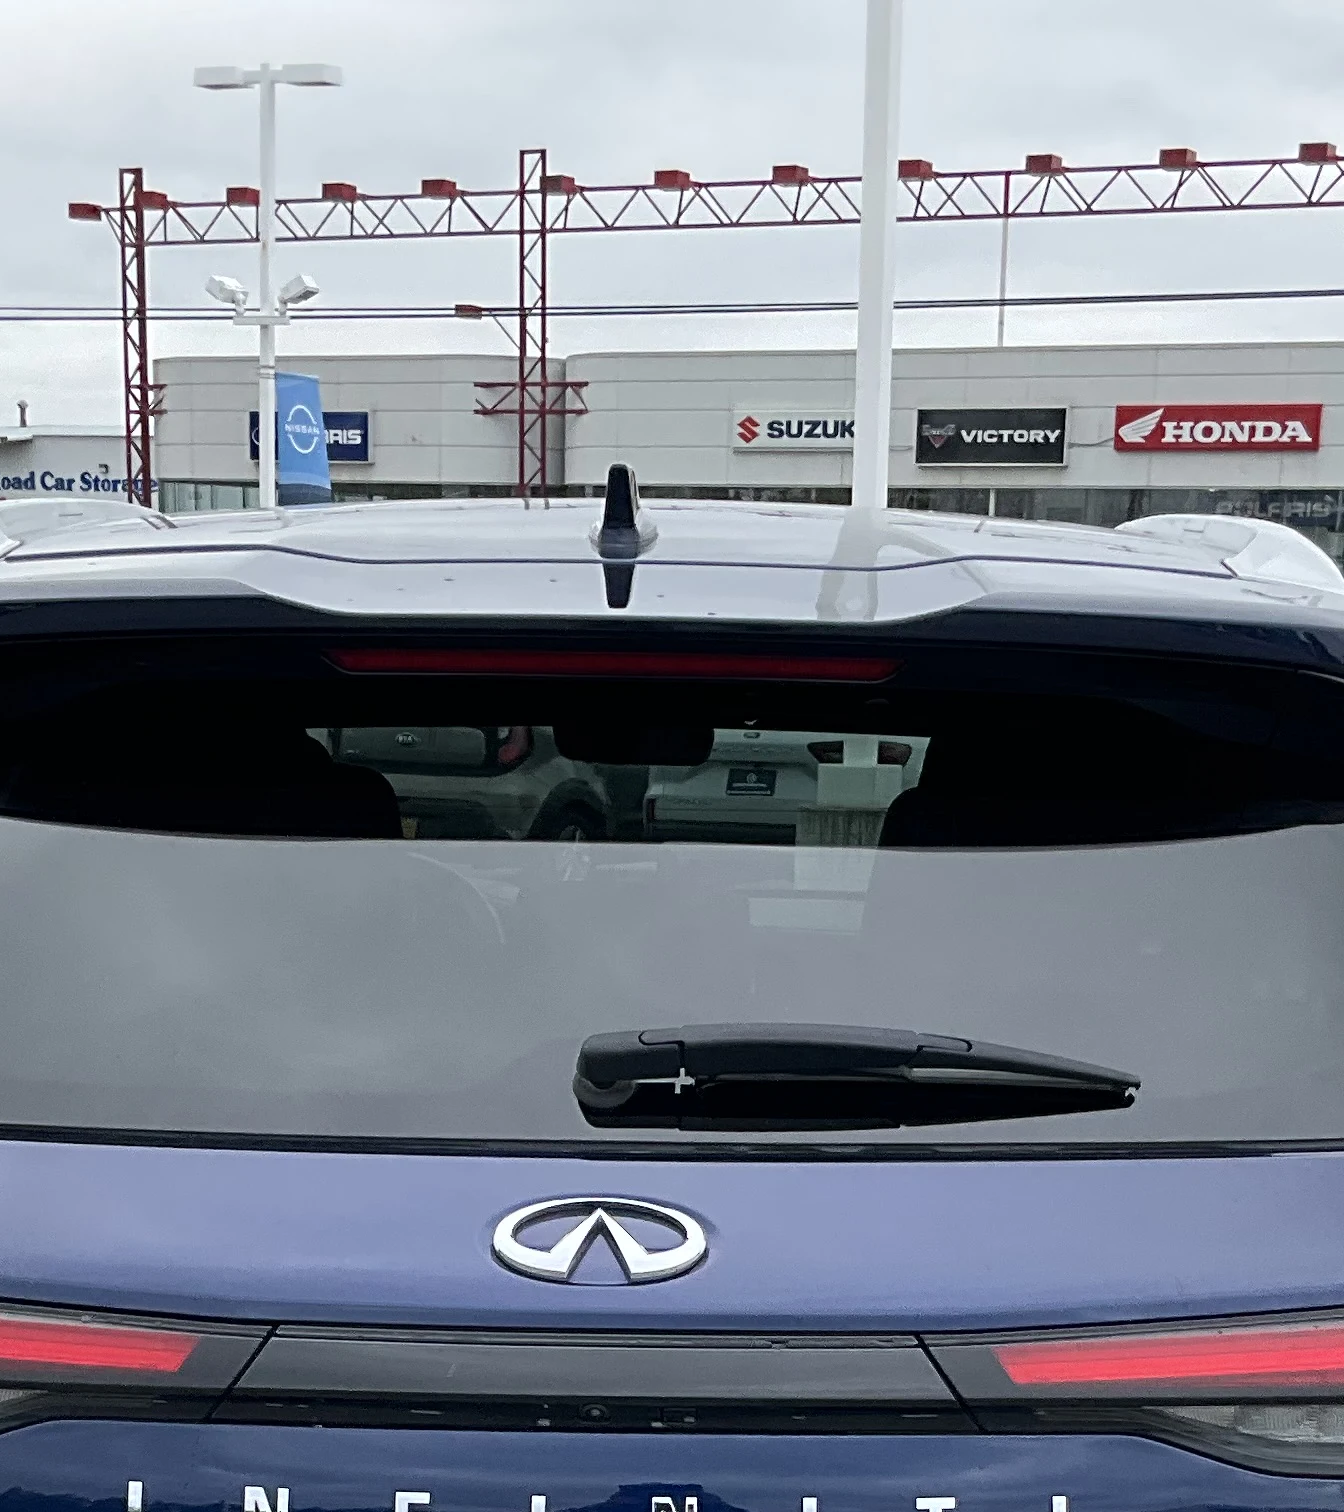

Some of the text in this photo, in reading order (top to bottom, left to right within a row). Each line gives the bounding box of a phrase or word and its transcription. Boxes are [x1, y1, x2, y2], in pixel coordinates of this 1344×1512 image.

[284, 423, 320, 435] NISSAN
[767, 419, 855, 439] SUZUK
[960, 428, 1061, 444] VICTORY
[1161, 420, 1313, 444] HONDA
[40, 470, 75, 492] Car
